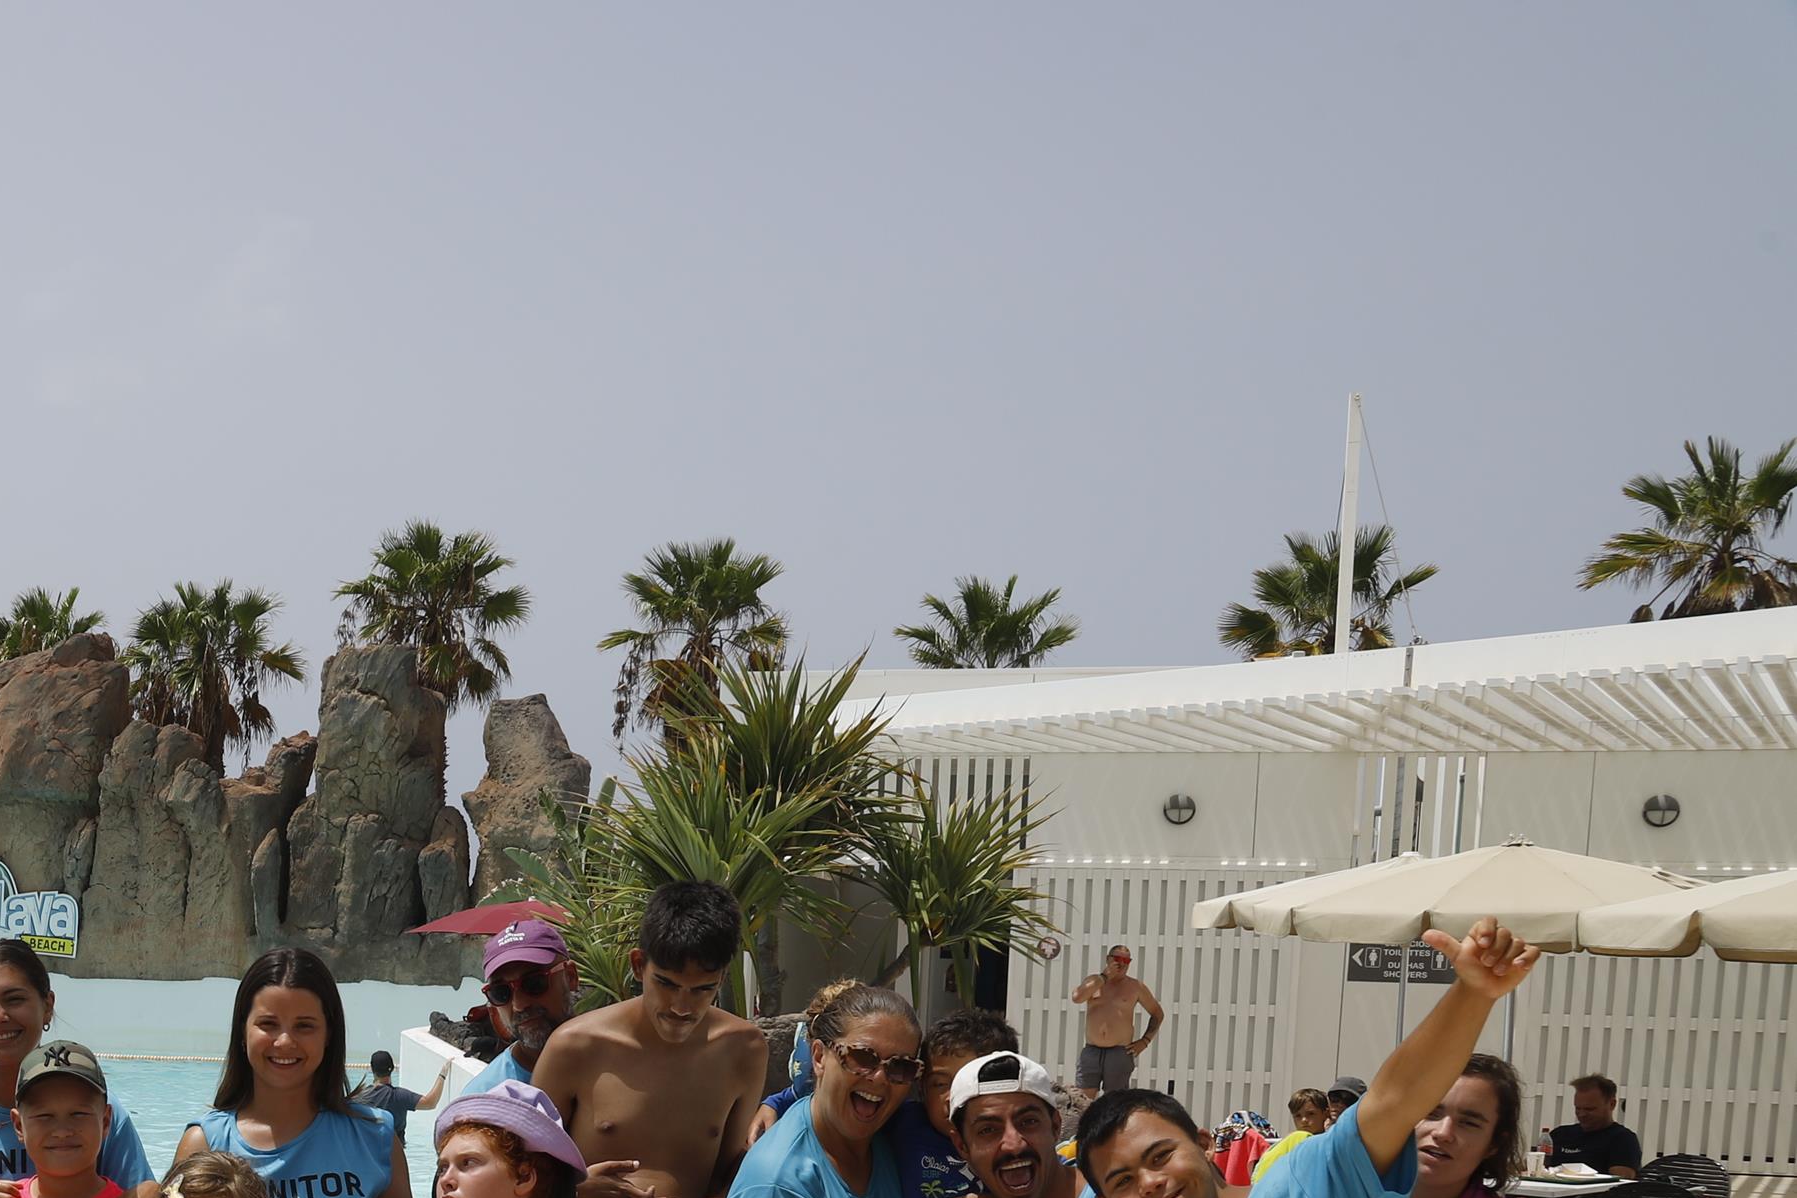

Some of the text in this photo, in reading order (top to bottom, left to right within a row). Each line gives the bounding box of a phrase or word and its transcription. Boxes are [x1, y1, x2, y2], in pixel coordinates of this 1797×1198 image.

[29, 936, 66, 953] BEACH
[1383, 948, 1431, 957] TOILTTES
[1387, 961, 1425, 970] DUHAS
[1383, 971, 1428, 979] SHOERS
